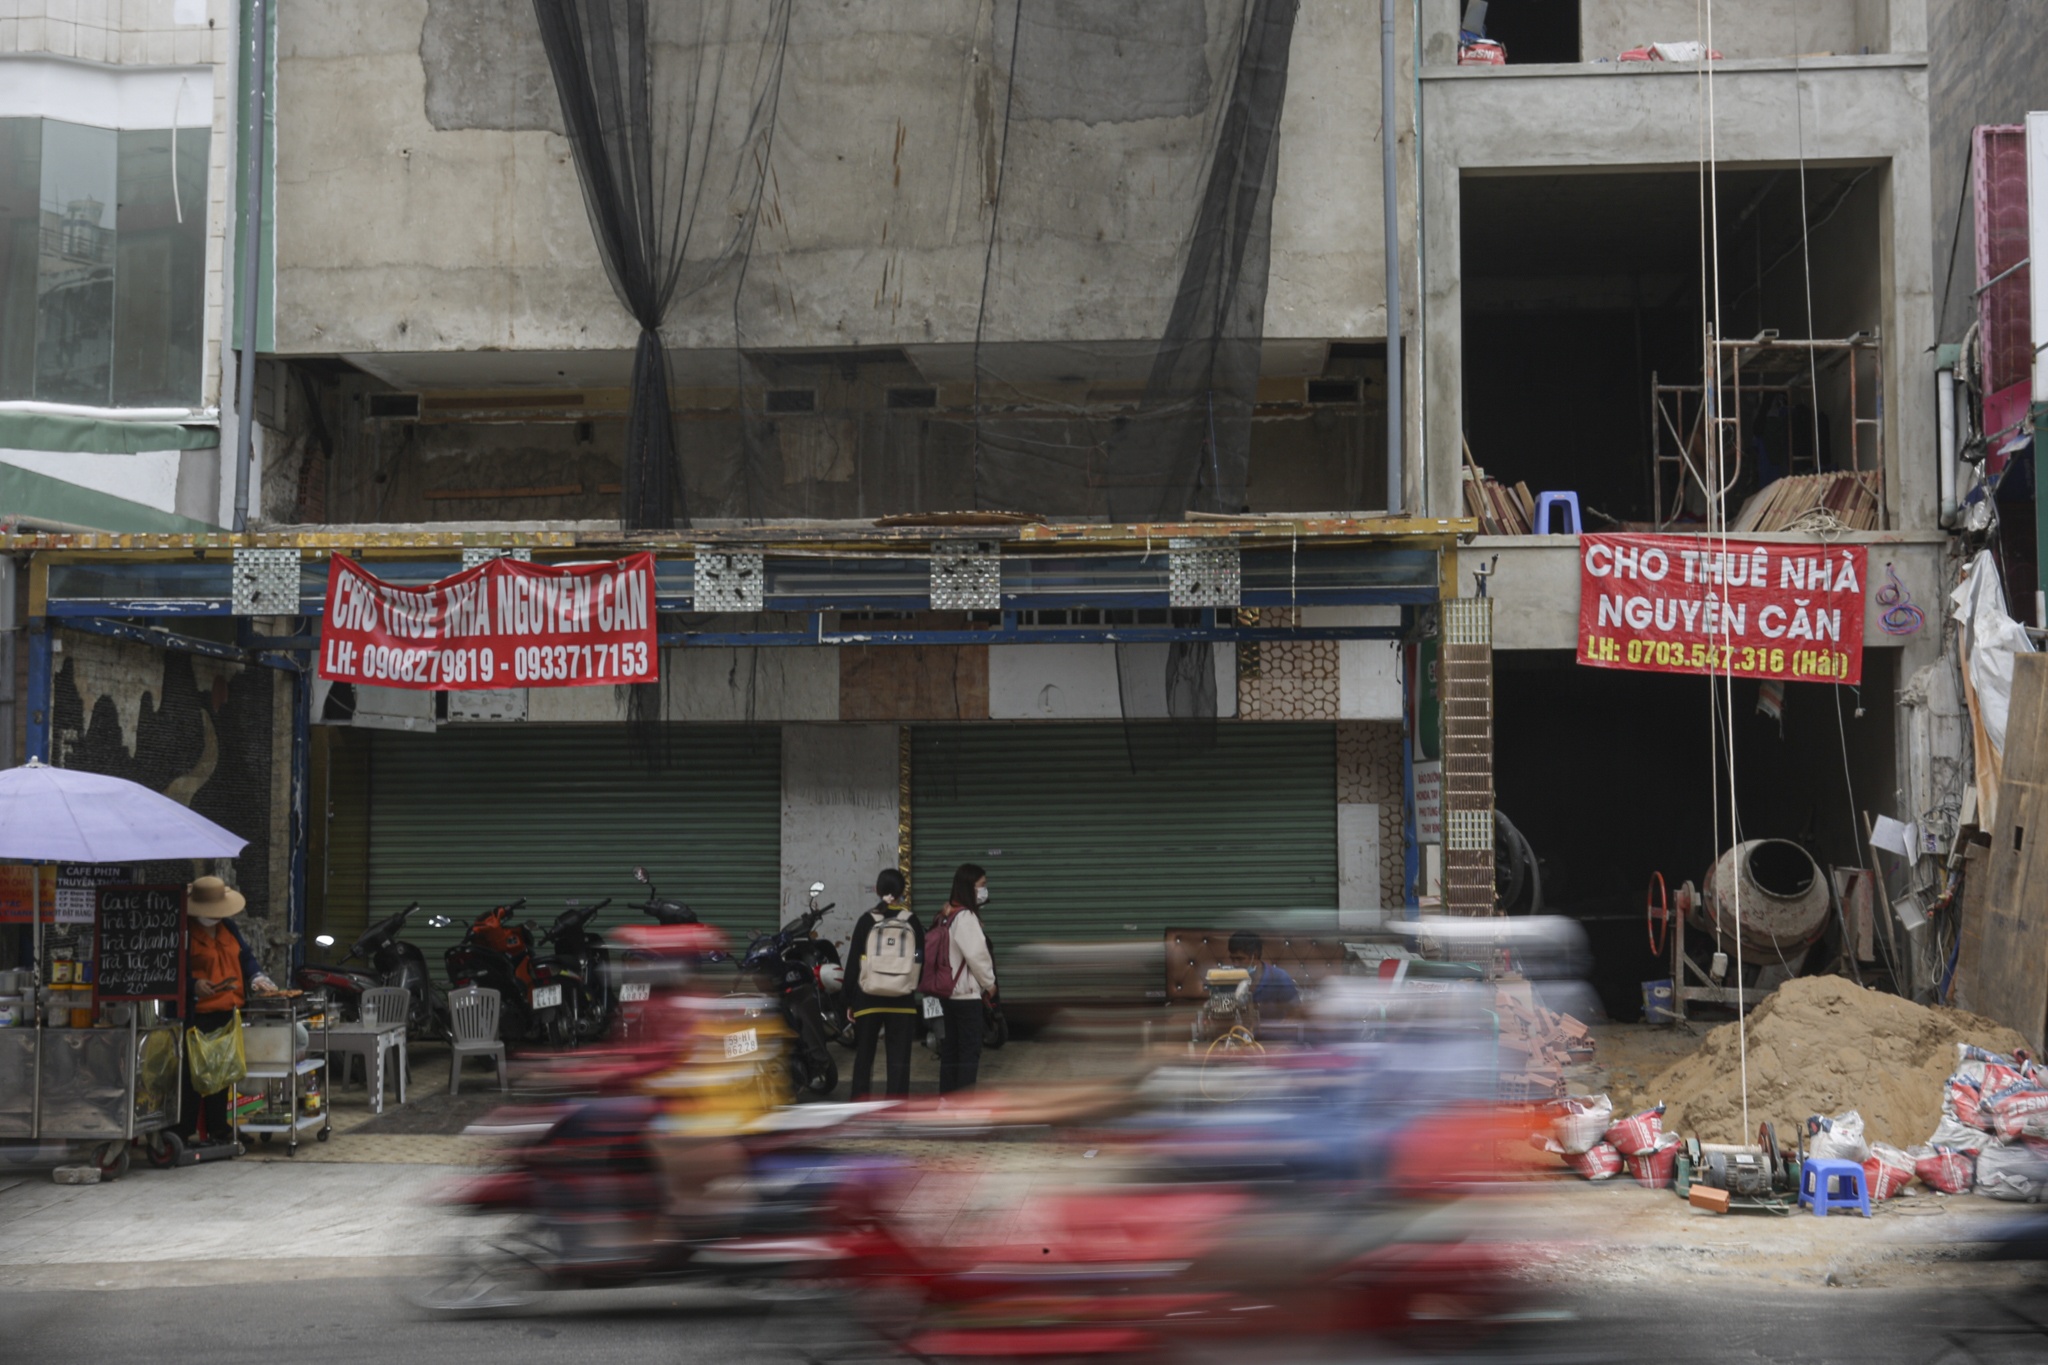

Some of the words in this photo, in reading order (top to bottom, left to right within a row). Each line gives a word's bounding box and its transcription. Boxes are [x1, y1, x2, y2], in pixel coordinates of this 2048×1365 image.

[1585, 543, 1669, 582] CHO
[1680, 545, 1768, 588] THUÊ
[1780, 550, 1860, 593] NHÀ
[597, 559, 648, 633] CĂN
[1597, 592, 1746, 636] NGUYÊN
[1758, 599, 1841, 642] CĂN
[326, 639, 356, 675] LH:
[362, 644, 494, 683] 0908279819
[515, 641, 648, 682] 0933717153
[1587, 635, 1620, 662] LH:
[1627, 639, 1784, 673] 0703.547.316
[1792, 648, 1848, 680] (Hải)
[66, 867, 91, 876] CAFE
[94, 867, 120, 876] PHIN
